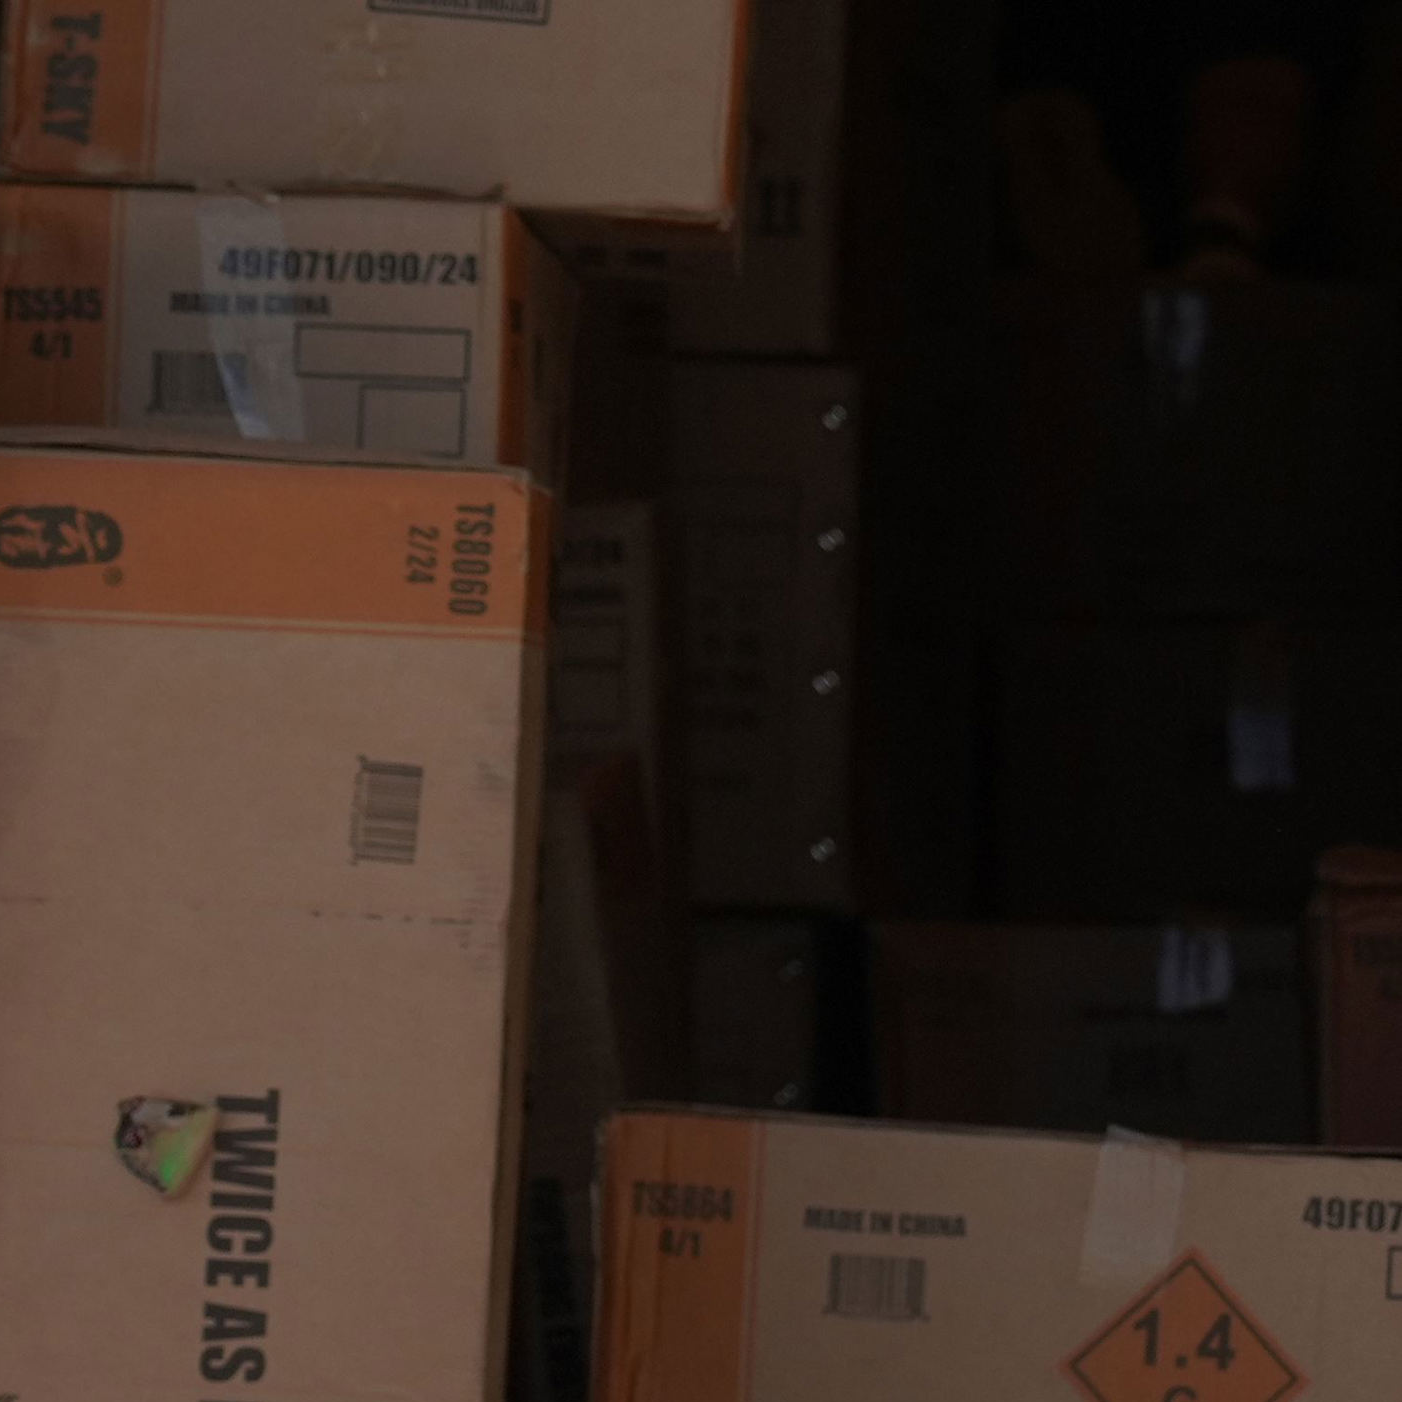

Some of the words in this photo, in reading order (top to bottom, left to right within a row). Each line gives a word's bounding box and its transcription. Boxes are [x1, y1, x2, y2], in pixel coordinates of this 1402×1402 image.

[41, 10, 103, 145] T-SKY
[218, 246, 479, 285] 49F071/090/24
[169, 291, 229, 315] MADE
[234, 293, 256, 316] IN
[262, 293, 333, 318] CHINA
[405, 524, 441, 588] 2/24
[448, 502, 495, 617] TS8060
[203, 1088, 281, 1289] TWICE
[804, 1203, 864, 1231] MADE
[869, 1209, 892, 1234] IN
[897, 1210, 968, 1238] CHINA
[199, 1302, 269, 1384] AS
[1130, 1307, 1238, 1372] 1.4
